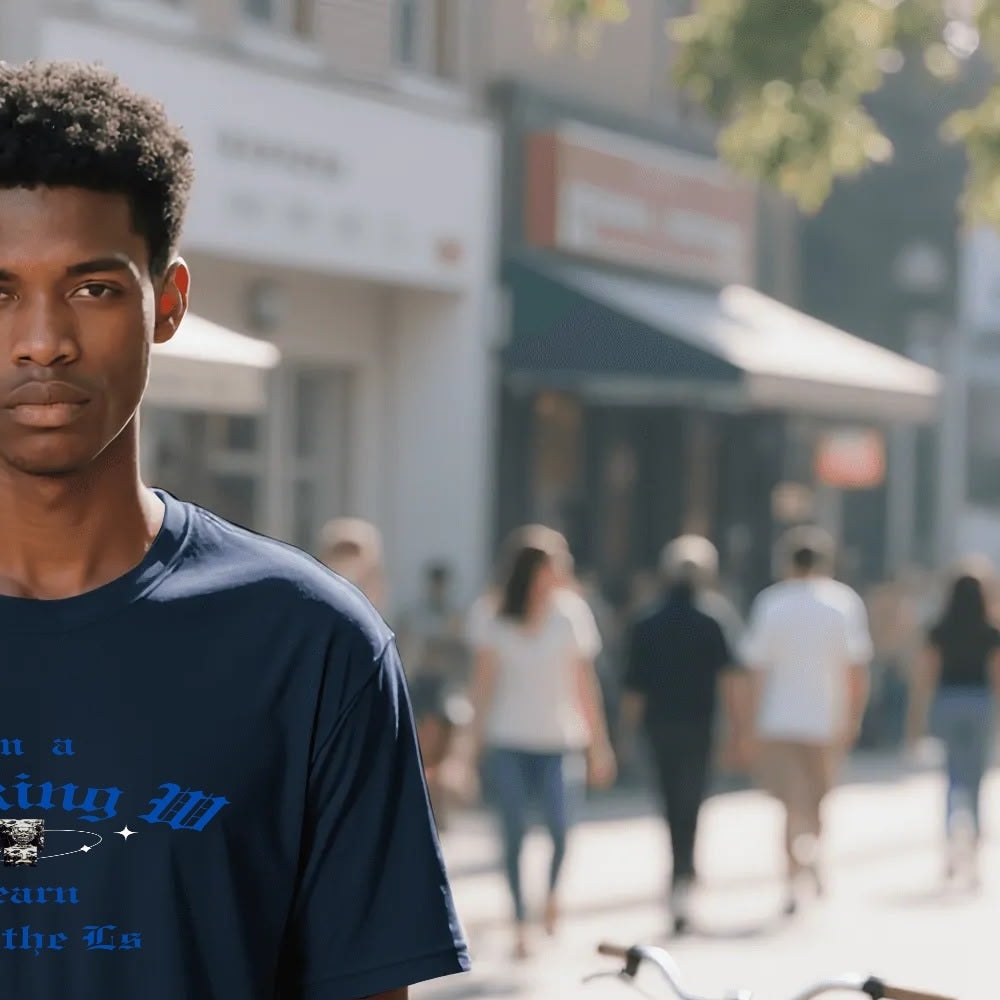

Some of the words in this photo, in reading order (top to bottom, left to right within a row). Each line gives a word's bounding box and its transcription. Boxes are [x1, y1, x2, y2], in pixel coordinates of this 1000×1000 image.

[51, 738, 76, 756] a
[138, 782, 231, 832] W
[2, 924, 68, 956] the
[82, 924, 143, 951] Ls
